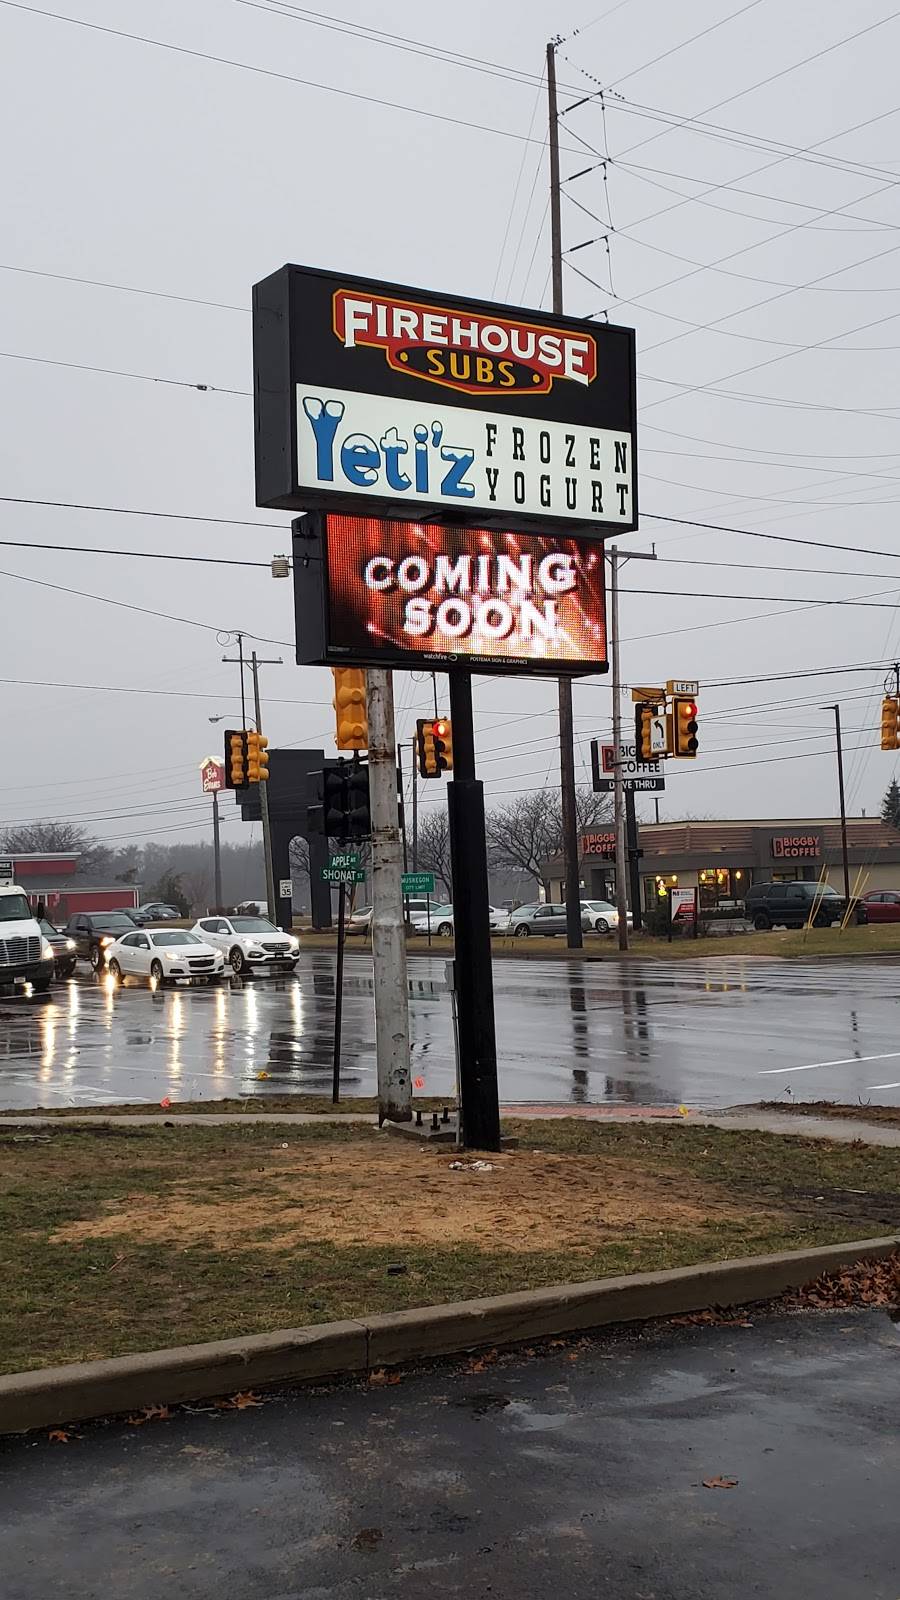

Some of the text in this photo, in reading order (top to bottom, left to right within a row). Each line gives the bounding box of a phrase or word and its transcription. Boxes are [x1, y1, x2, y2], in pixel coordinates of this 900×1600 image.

[342, 298, 591, 387] FIREHOUSE
[425, 348, 518, 388] SUBS
[302, 396, 476, 500] Yeti'z
[485, 422, 630, 475] FROZEN
[485, 467, 630, 516] YOGURT
[364, 551, 577, 595] COMING
[403, 595, 560, 641] SOON
[675, 684, 695, 692] LEFT
[619, 745, 636, 757] BIG
[608, 780, 656, 790] DVE THRU
[589, 832, 616, 843] BIGGB
[783, 836, 819, 847] BIGGBY
[589, 843, 617, 854] COFF
[784, 847, 821, 857] COFFEE
[331, 855, 350, 867] APPLE
[322, 868, 357, 881] SHONAT
[281, 888, 291, 896] 35
